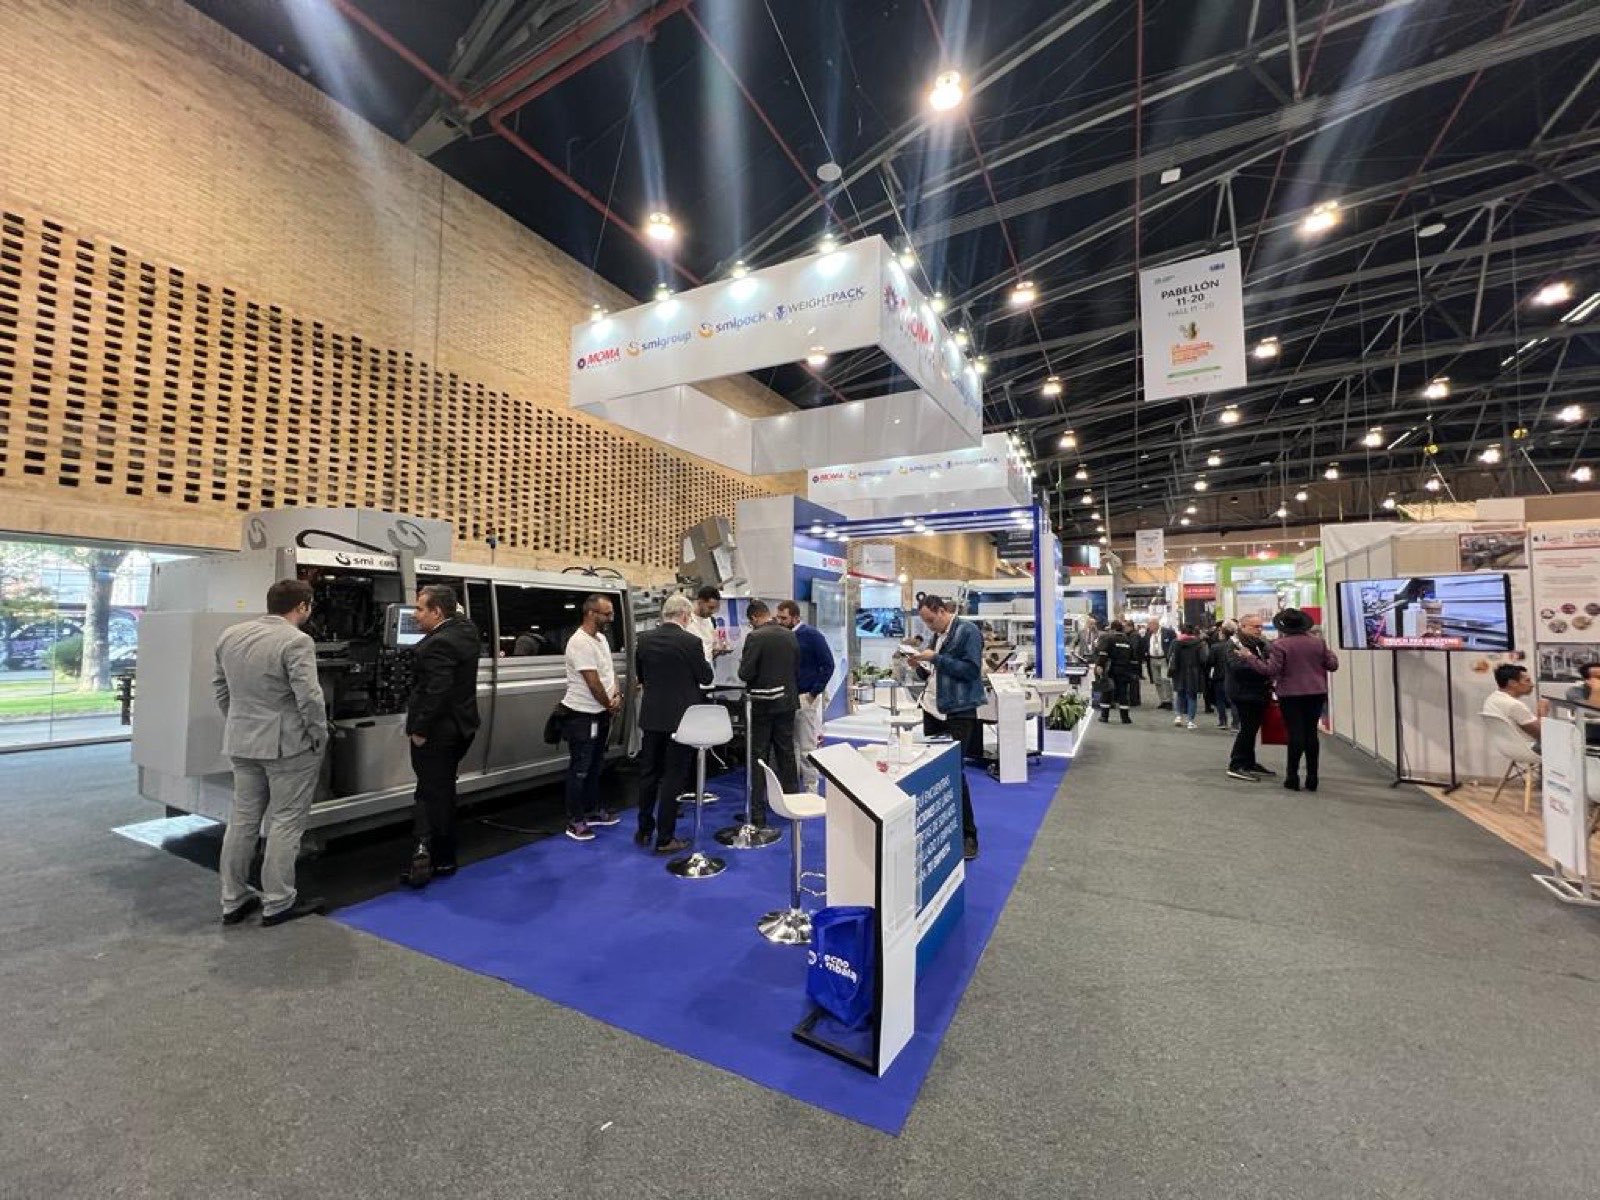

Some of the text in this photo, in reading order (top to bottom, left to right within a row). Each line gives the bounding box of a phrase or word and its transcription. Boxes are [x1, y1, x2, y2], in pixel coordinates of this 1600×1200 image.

[1161, 279, 1220, 300] PABELLÓN
[788, 286, 865, 313] WEIGHTPACK
[1176, 294, 1205, 306] 11-20
[587, 348, 620, 364] MOMA
